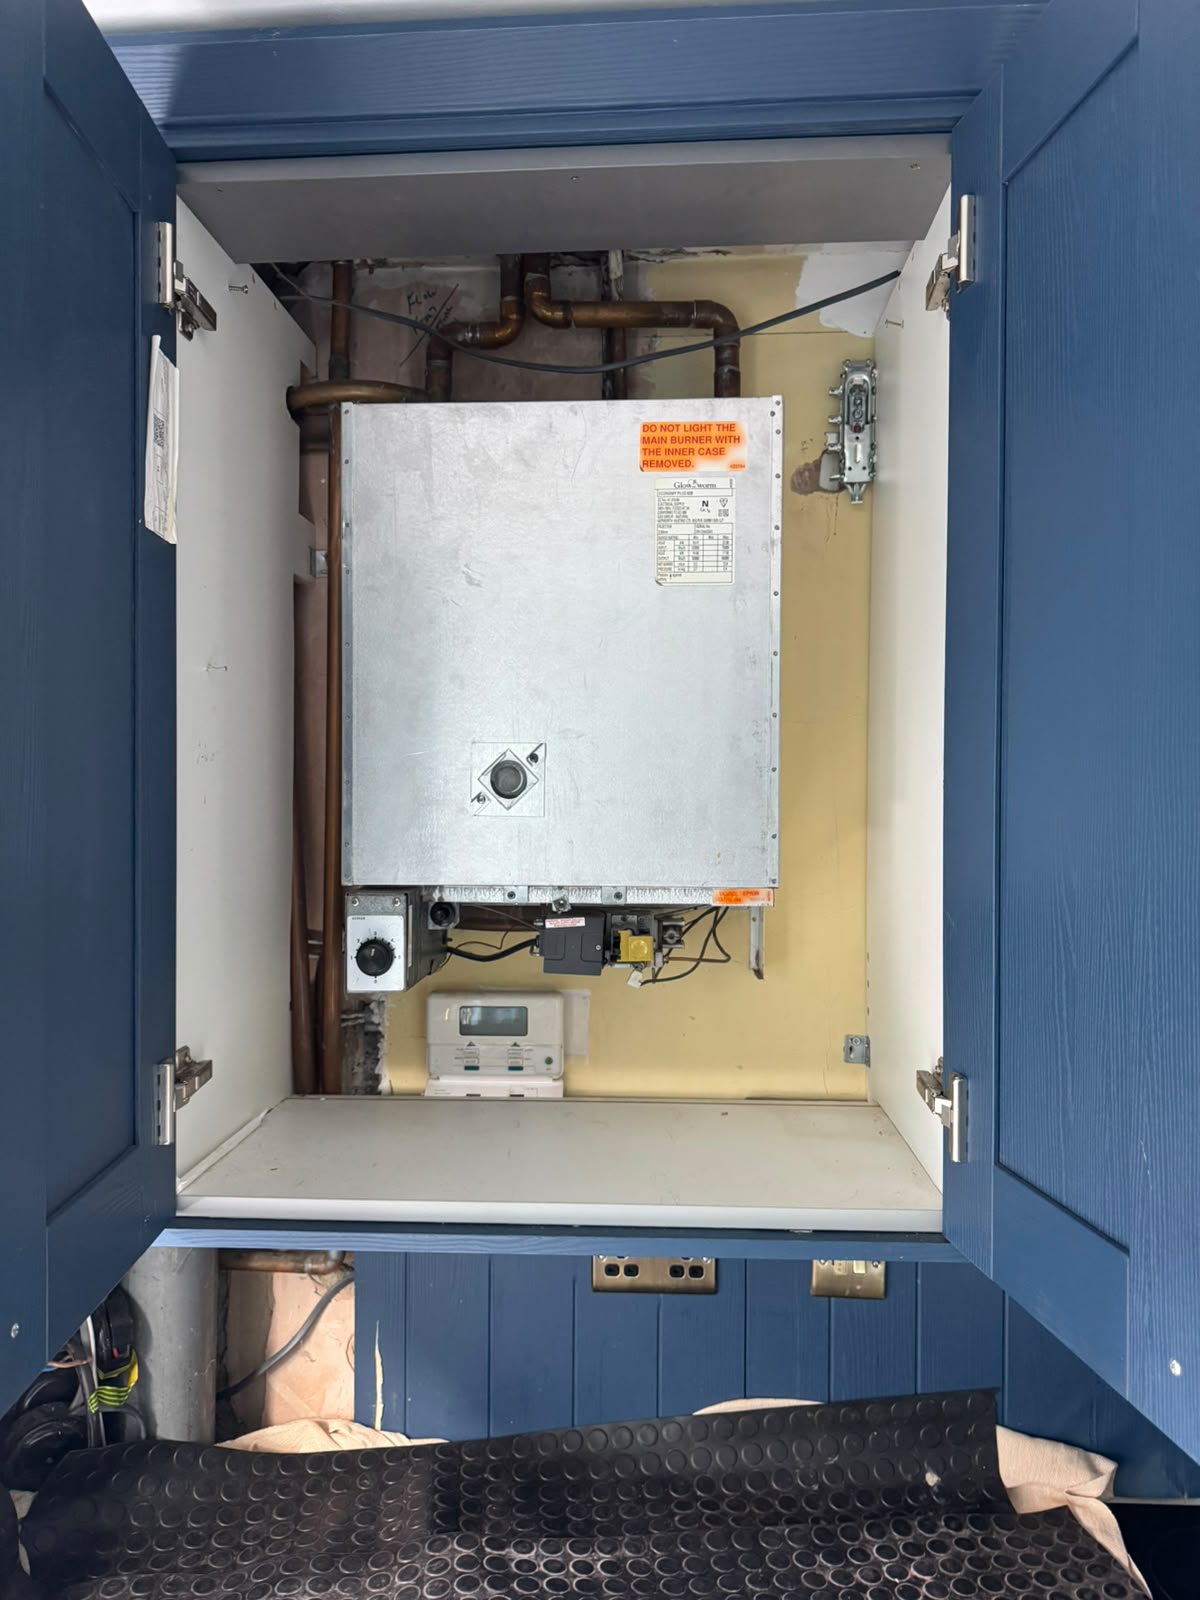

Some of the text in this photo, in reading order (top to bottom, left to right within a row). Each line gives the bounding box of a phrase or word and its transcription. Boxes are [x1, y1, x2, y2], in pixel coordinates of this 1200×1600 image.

[642, 423, 736, 432] DO NOT LIGHT THE
[642, 436, 741, 444] MAIN BURNER WITH
[642, 447, 726, 456] THE INNER CASE
[642, 459, 694, 468] REMOVED.
